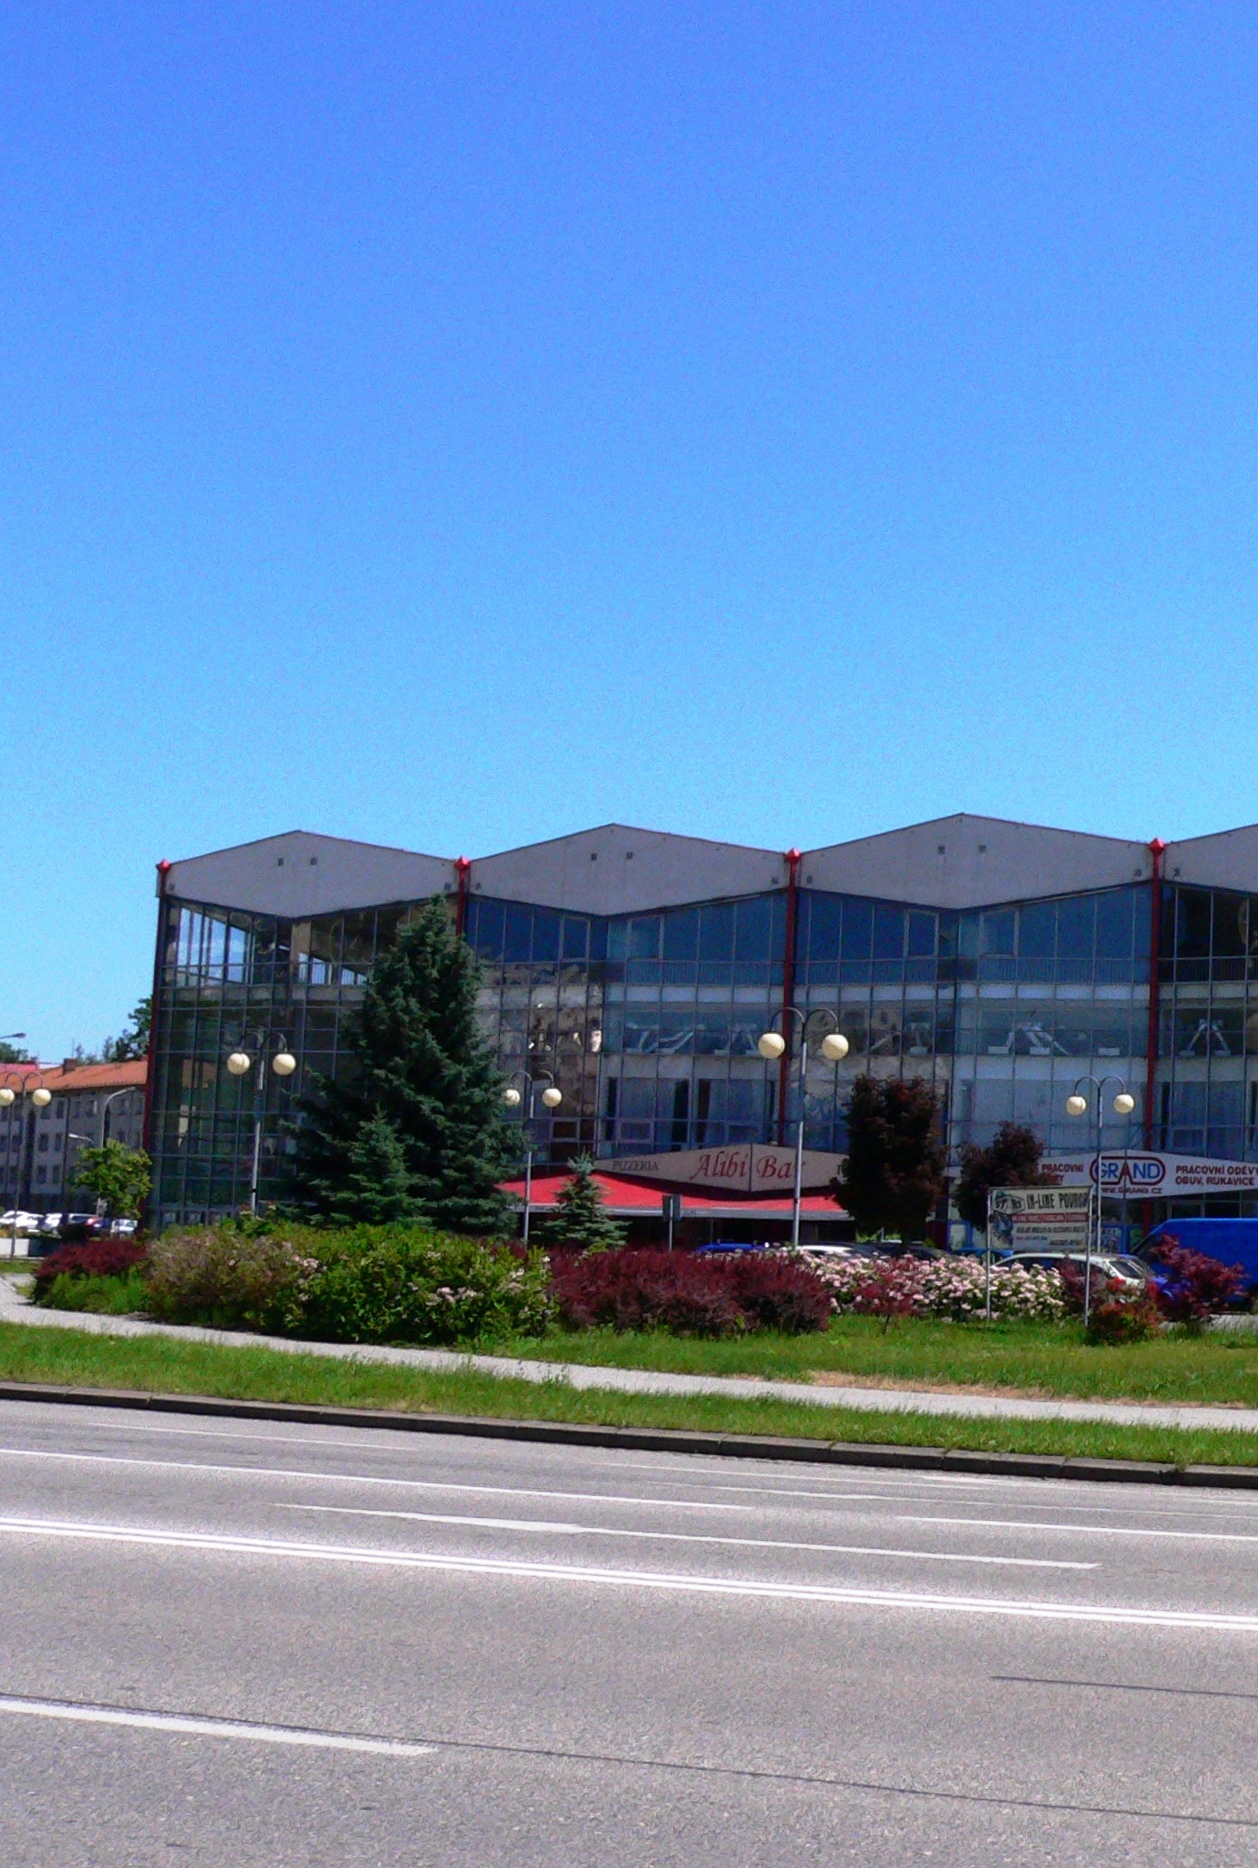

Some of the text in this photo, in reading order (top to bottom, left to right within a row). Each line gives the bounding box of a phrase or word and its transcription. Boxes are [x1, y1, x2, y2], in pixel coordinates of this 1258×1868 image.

[612, 1160, 659, 1171] PIZZERIA
[689, 1151, 749, 1181] Alibi
[1095, 1162, 1160, 1179] GRAND
[1175, 1164, 1225, 1175] PRACOVNÍ
[1175, 1176, 1255, 1186] OBUV, RUKAVICE
